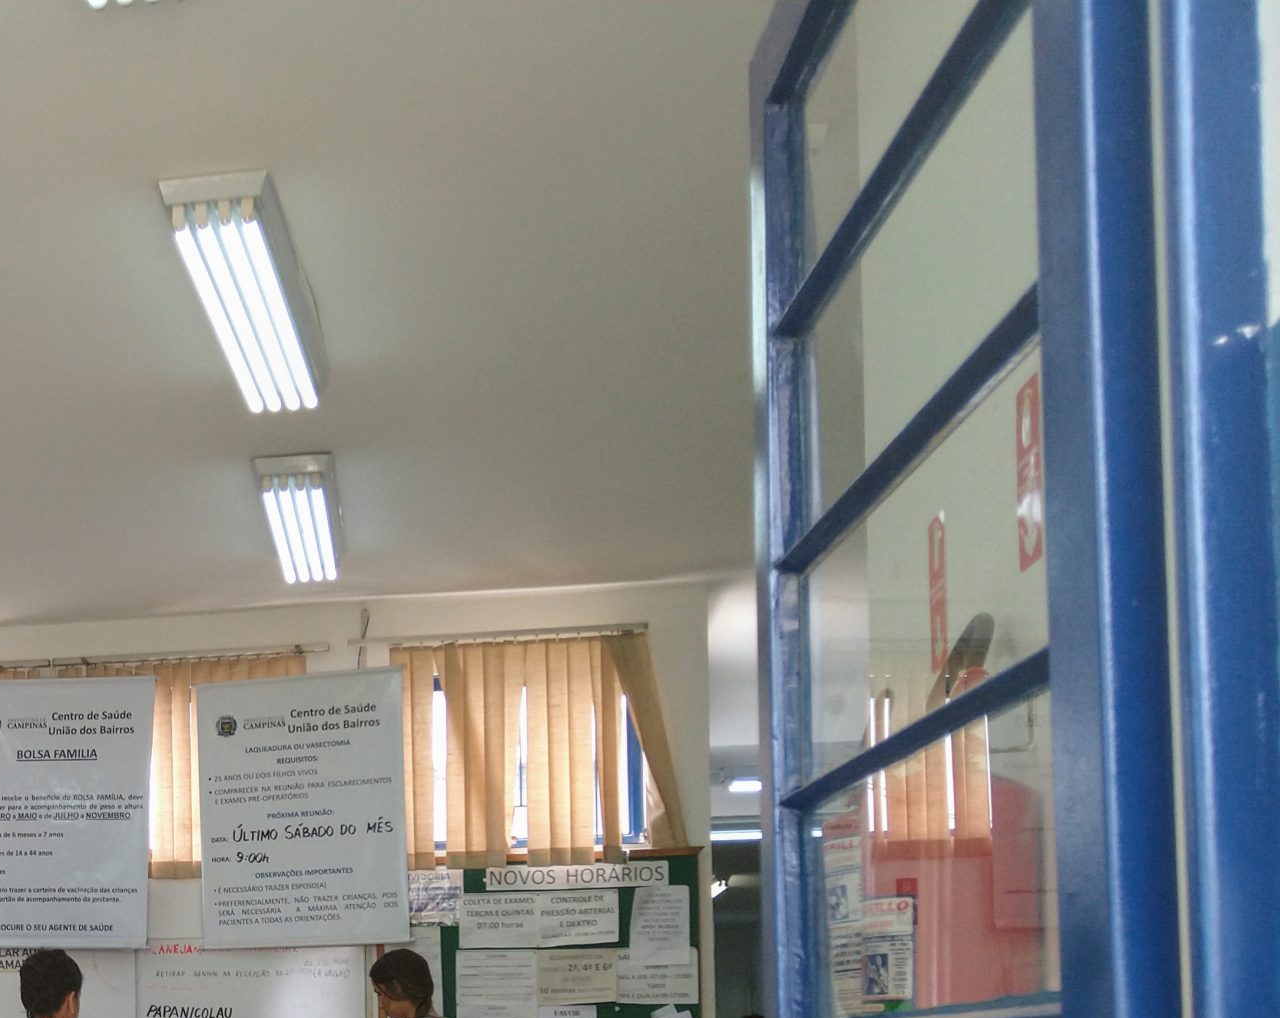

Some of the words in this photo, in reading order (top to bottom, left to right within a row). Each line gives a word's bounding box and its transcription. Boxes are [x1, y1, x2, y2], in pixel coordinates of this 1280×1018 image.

[52, 711, 84, 721] Centro
[87, 711, 99, 720] de
[102, 710, 132, 719] Saúde
[291, 709, 325, 718] Centro
[328, 706, 341, 715] de
[345, 703, 376, 714] Saúde
[7, 722, 47, 730] CAMPINAS
[48, 726, 77, 735] União
[80, 725, 97, 735] dos
[100, 725, 134, 734] Bairros
[243, 721, 286, 730] CAMPINAS
[288, 723, 318, 733] União
[322, 721, 340, 731] dos
[343, 719, 380, 729] Bairros
[245, 743, 292, 753] LAQUEADURA
[306, 740, 350, 748] VASECTOMIA
[17, 750, 50, 759] BOLSA
[54, 749, 97, 758] FAMILIA
[215, 787, 258, 795] COMPARECER
[274, 782, 304, 791] REUNIÃO
[328, 777, 392, 787] ESCLARECIMENTOS
[267, 811, 299, 820] PRÓXIMA
[233, 824, 277, 842] ÚLTIMO
[285, 823, 333, 840] SÁBADO
[340, 824, 356, 835] DO
[236, 852, 269, 863] 9:00h
[255, 869, 303, 879] OBSERVAÇÕES
[305, 867, 353, 876] IMPORTANTES
[489, 869, 556, 886] NOVOS
[566, 863, 664, 884] HORÁRIOS
[223, 885, 263, 893] NECESSÁRIO
[551, 896, 591, 904] CONTROLE
[242, 907, 281, 915] NECESSÁRIA
[345, 902, 376, 910] ATENÇÃO
[541, 908, 576, 916] PRESSÃO
[89, 923, 113, 932] SAÚDE
[146, 1004, 232, 1018] PAPANICOLAU
